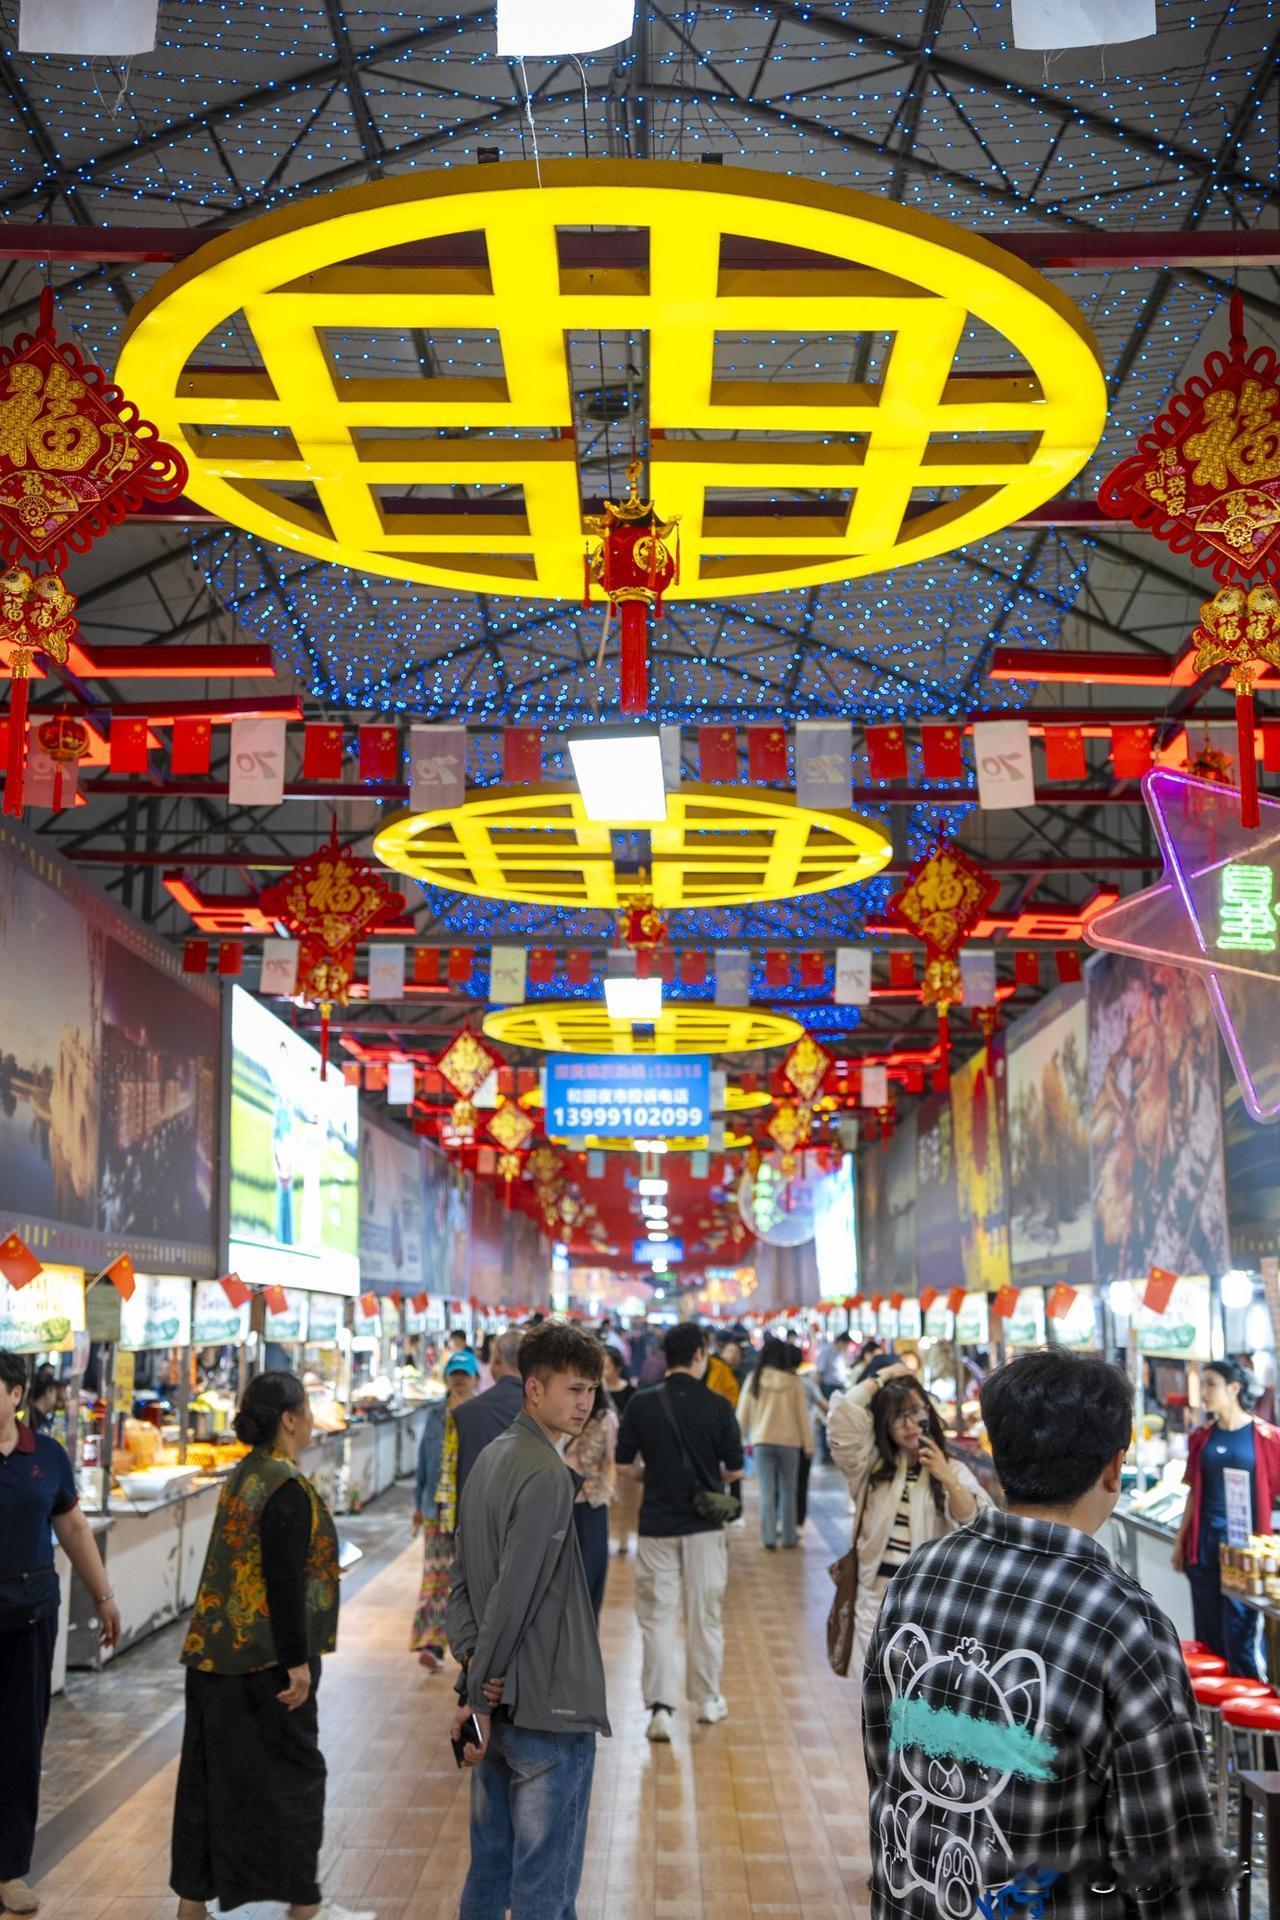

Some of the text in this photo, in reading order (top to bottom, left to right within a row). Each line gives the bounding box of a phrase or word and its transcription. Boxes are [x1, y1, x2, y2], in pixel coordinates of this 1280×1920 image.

[0, 363, 100, 472] 福
[1182, 379, 1280, 489] 福
[553, 1107, 703, 1127] 13999102099
